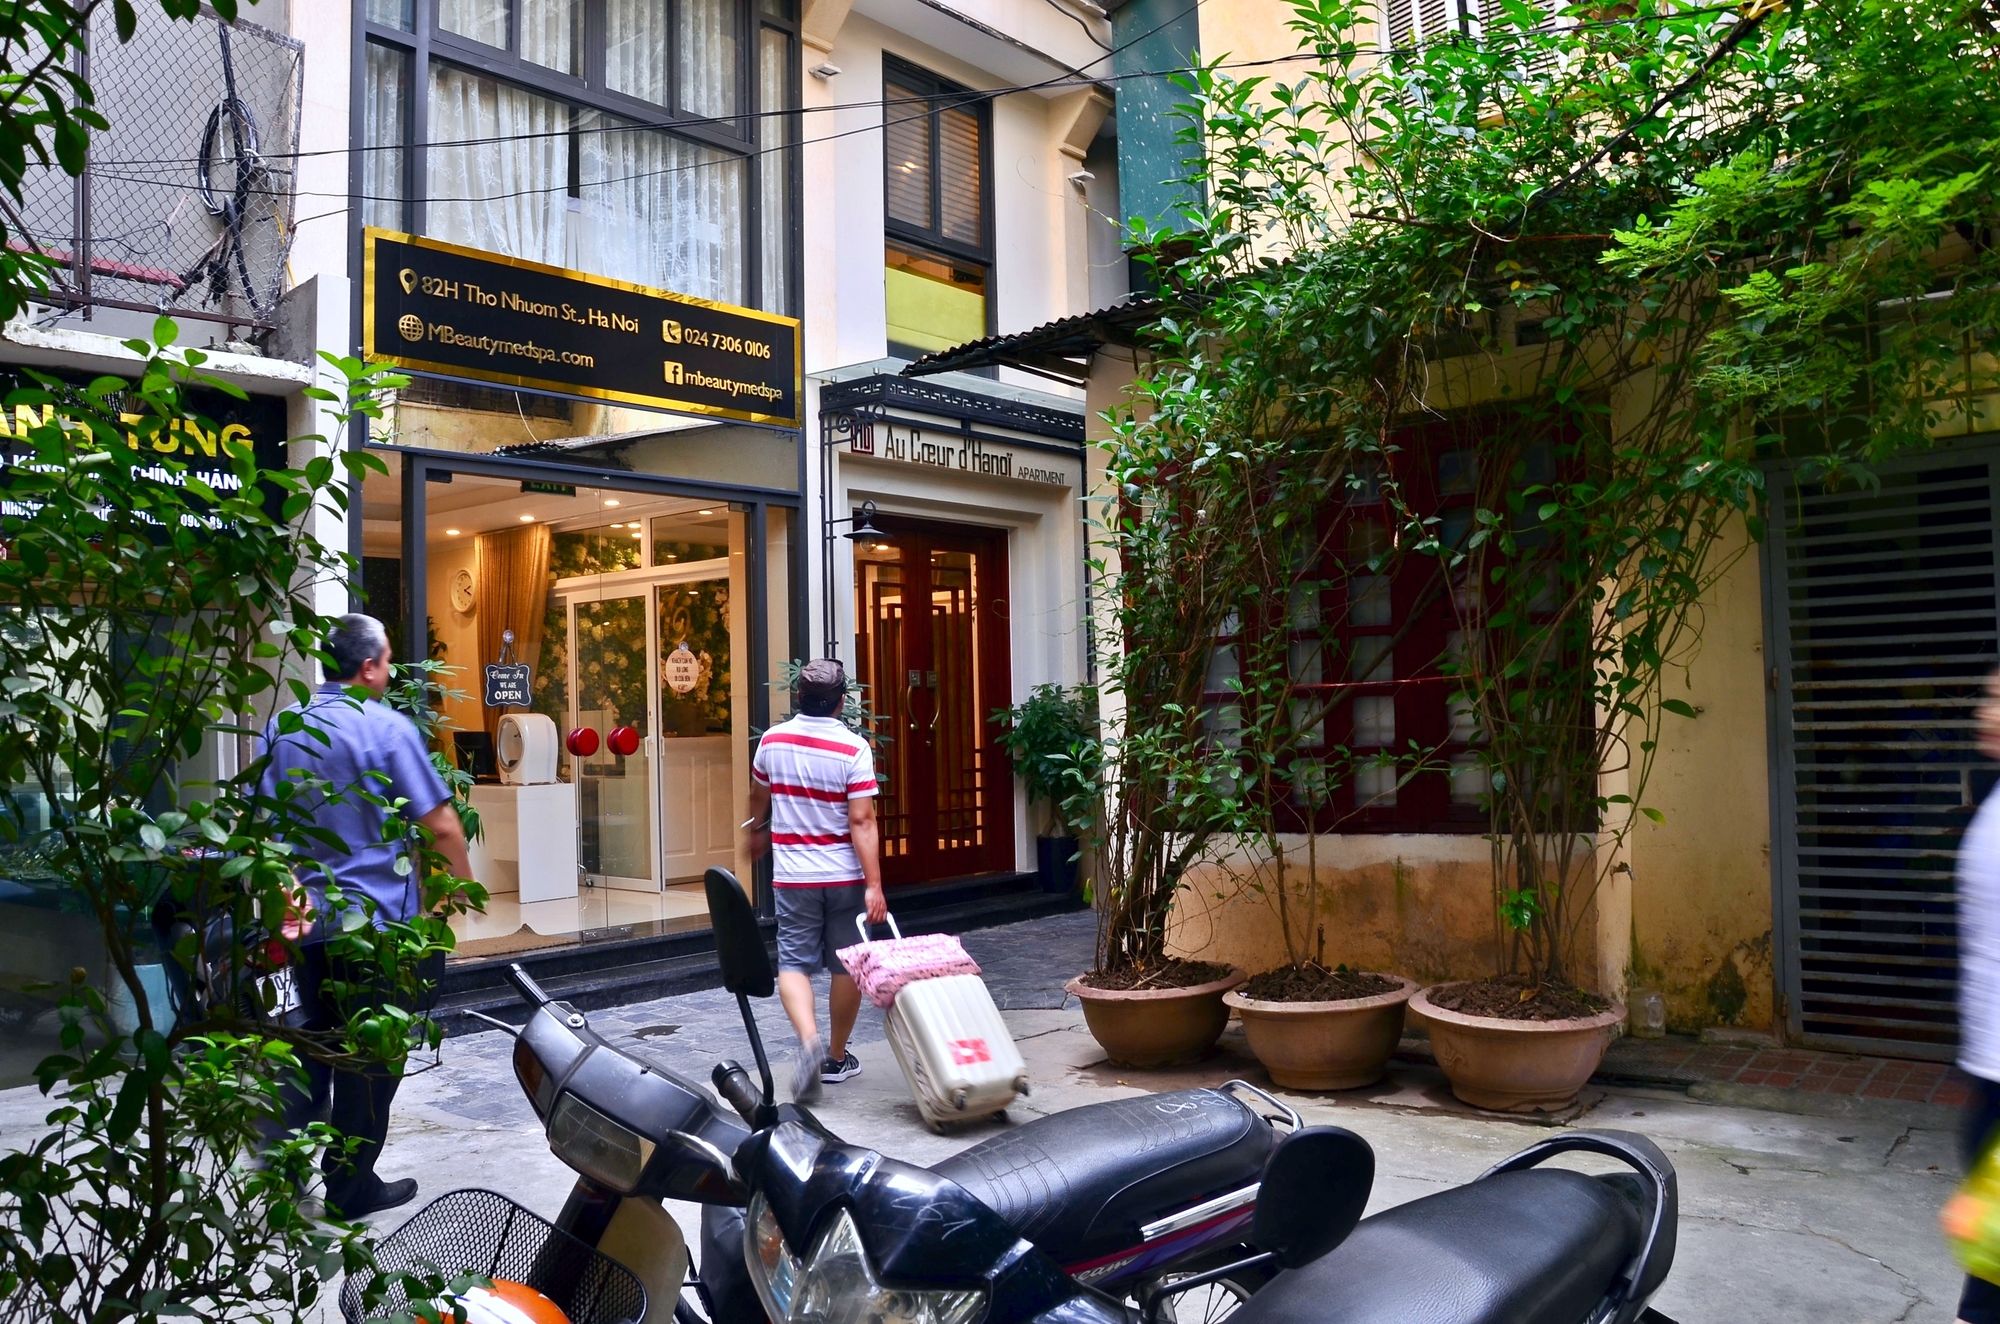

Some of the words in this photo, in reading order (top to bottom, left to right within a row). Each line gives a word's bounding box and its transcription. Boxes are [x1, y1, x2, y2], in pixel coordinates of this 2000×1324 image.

[422, 276, 458, 299] 82H
[464, 283, 497, 307] Tho
[501, 290, 558, 319] Nhuom
[588, 308, 609, 329] Ha
[612, 313, 639, 334] Noi
[684, 328, 709, 348] 024
[711, 333, 742, 354] 7306
[744, 340, 771, 359] 0106
[685, 370, 783, 403] mbeautymedspa
[885, 425, 905, 460] Au
[911, 429, 954, 468] Cœur
[959, 438, 1013, 477] d'Hanoï
[1018, 466, 1065, 485] APARTMENT
[489, 669, 510, 680] Come
[500, 681, 508, 689] WE
[508, 681, 517, 689] ARE
[494, 690, 522, 700] OPEN
